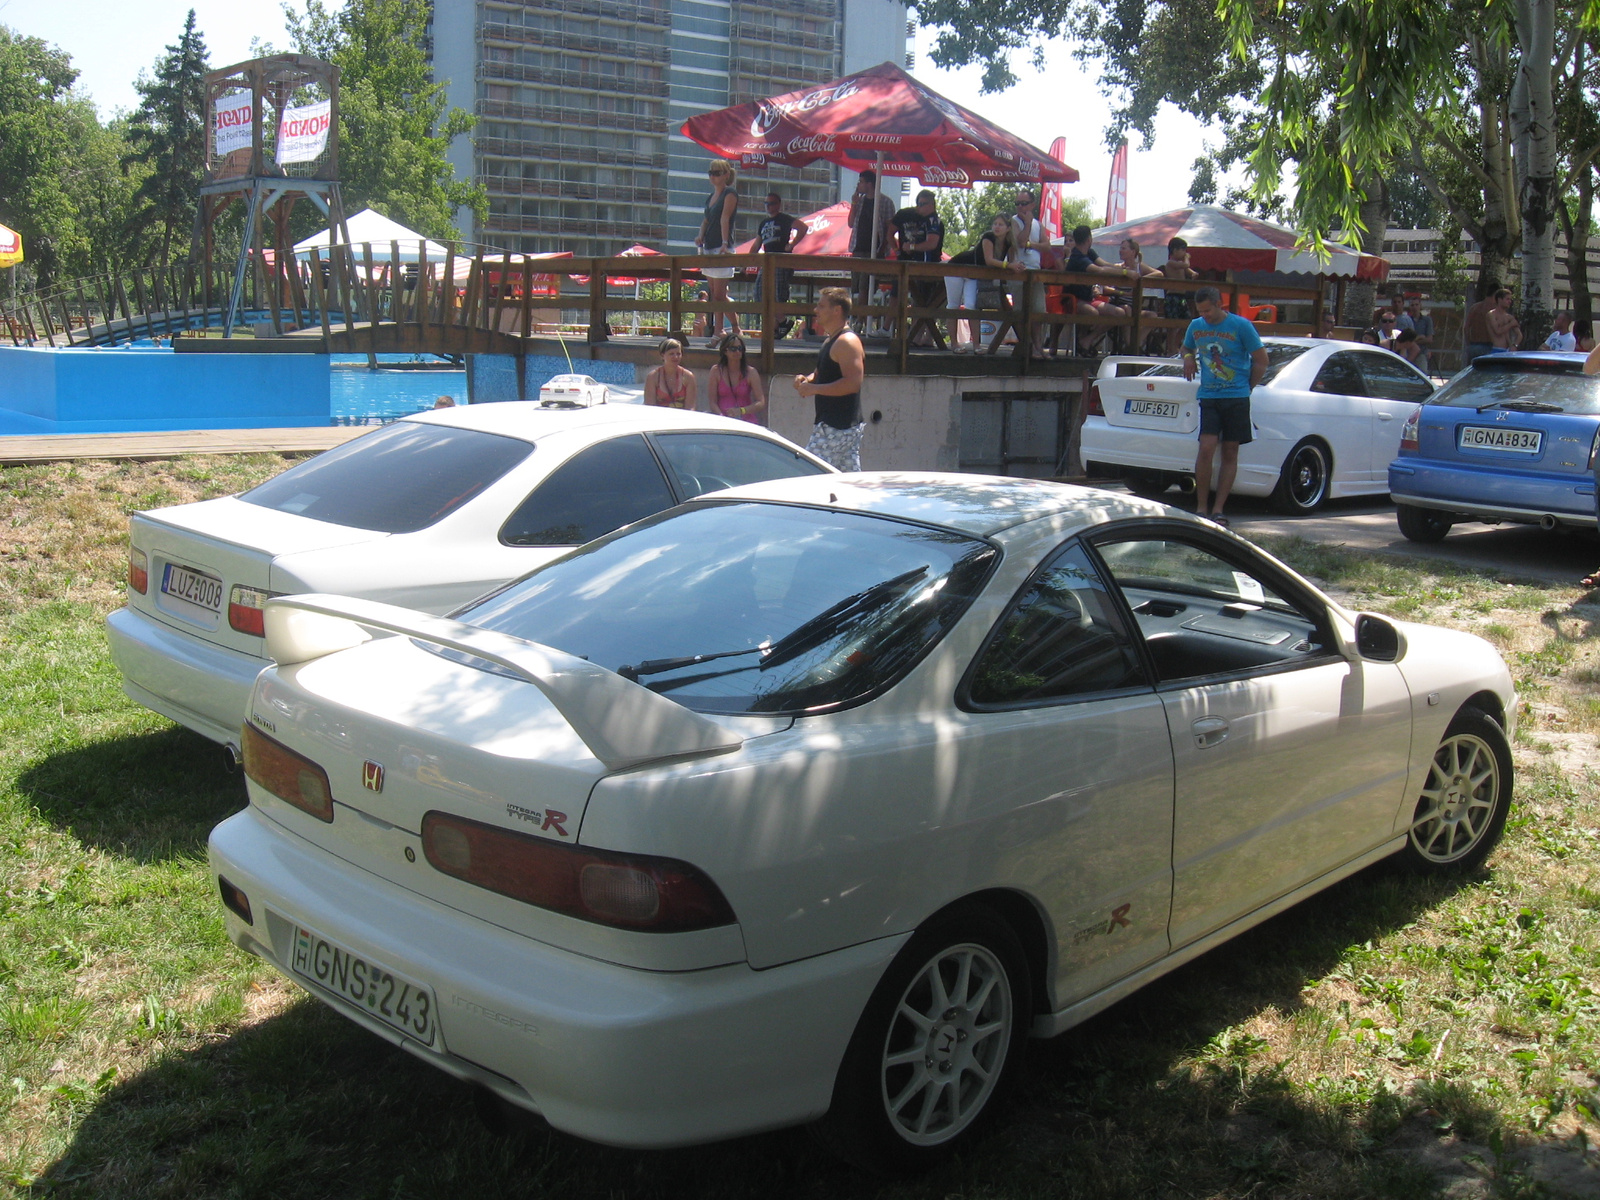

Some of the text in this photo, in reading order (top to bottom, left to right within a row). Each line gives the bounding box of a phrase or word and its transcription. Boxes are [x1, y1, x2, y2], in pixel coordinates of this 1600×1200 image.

[787, 133, 837, 154] Coca-Cola
[849, 134, 874, 143] SOLD
[875, 135, 902, 144] HERE
[541, 808, 569, 836] R
[1107, 903, 1131, 935] R
